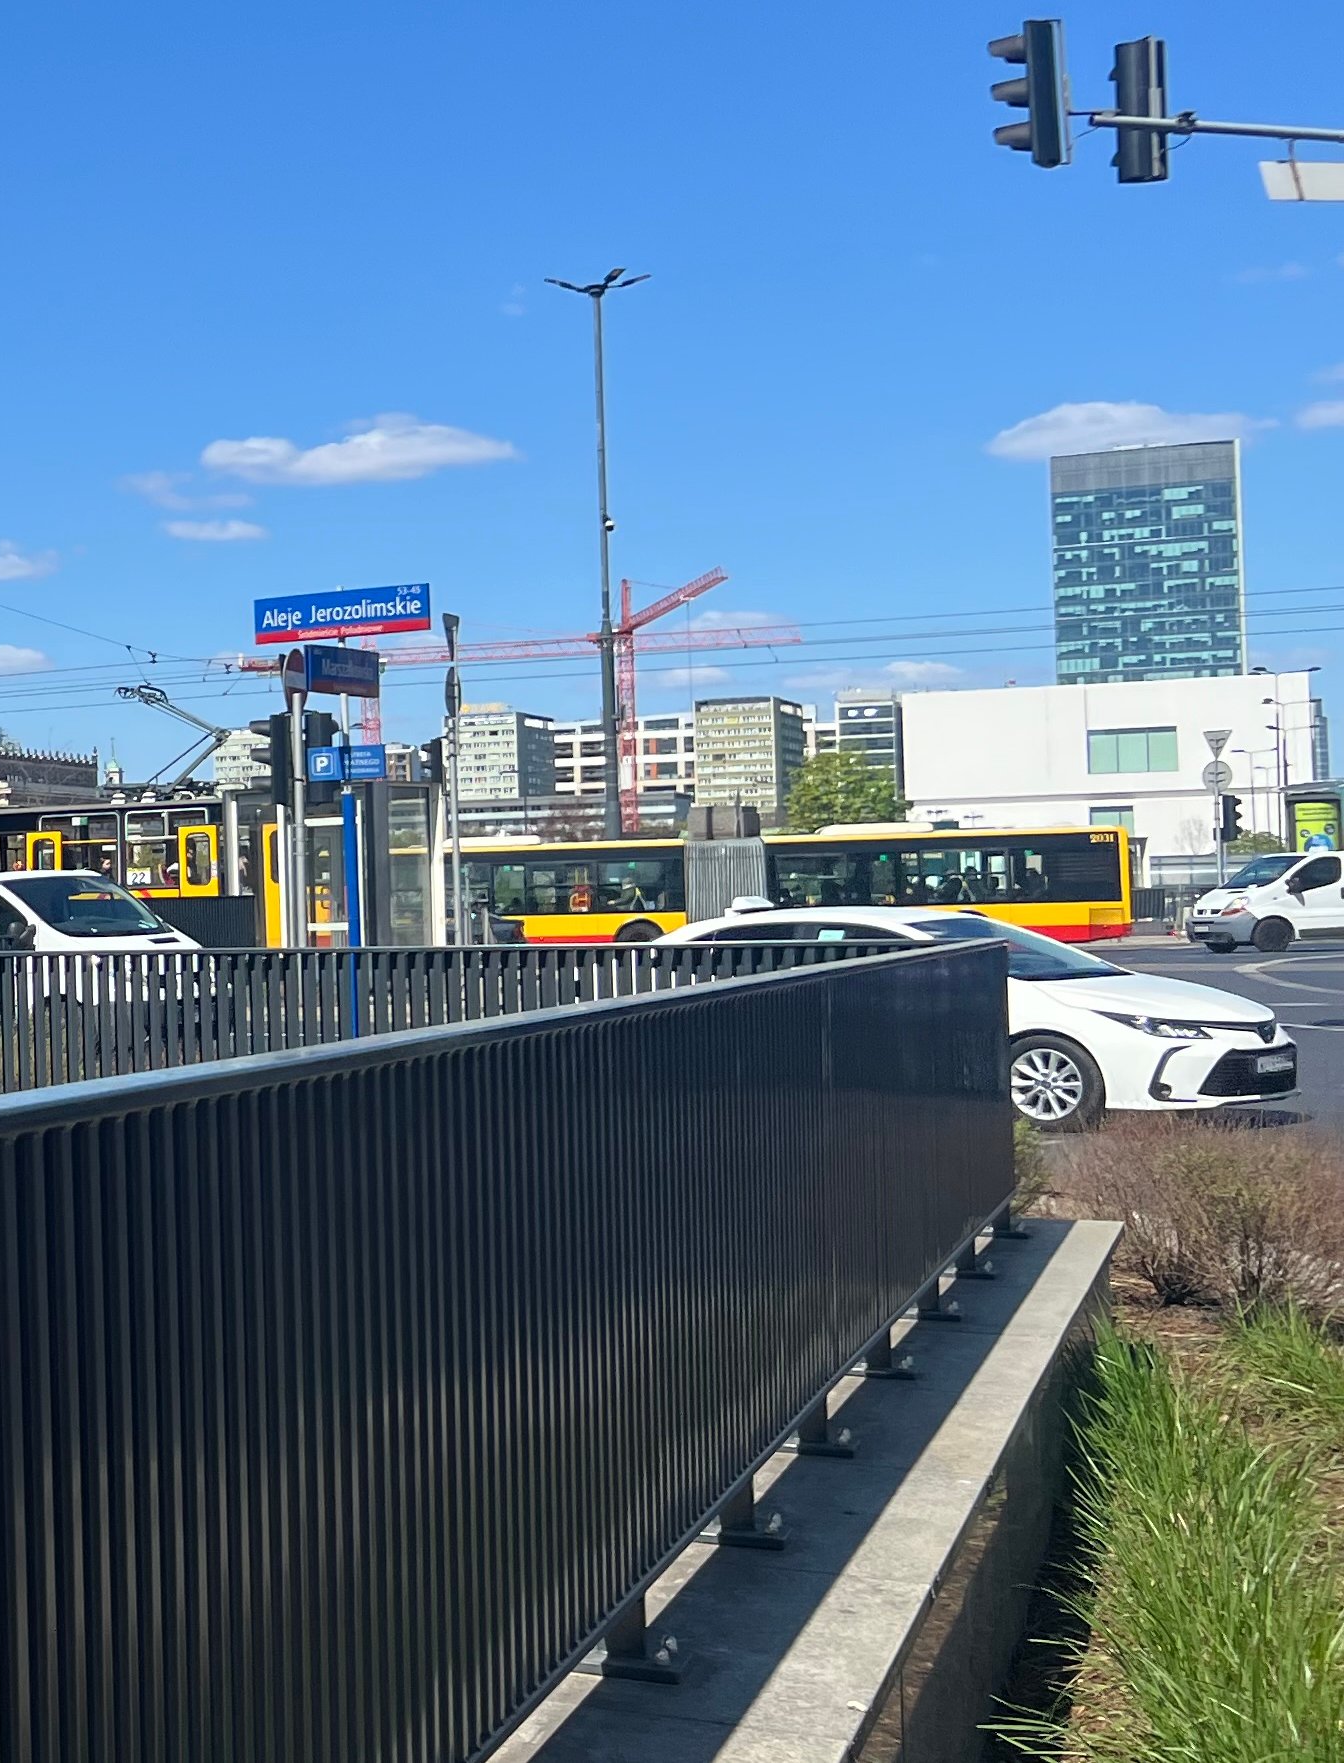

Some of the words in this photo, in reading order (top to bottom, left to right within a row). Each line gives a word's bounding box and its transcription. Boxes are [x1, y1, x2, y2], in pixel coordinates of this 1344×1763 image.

[262, 608, 302, 631] Aleje
[309, 596, 421, 624] Jerozolimskie
[131, 872, 146, 883] 22
